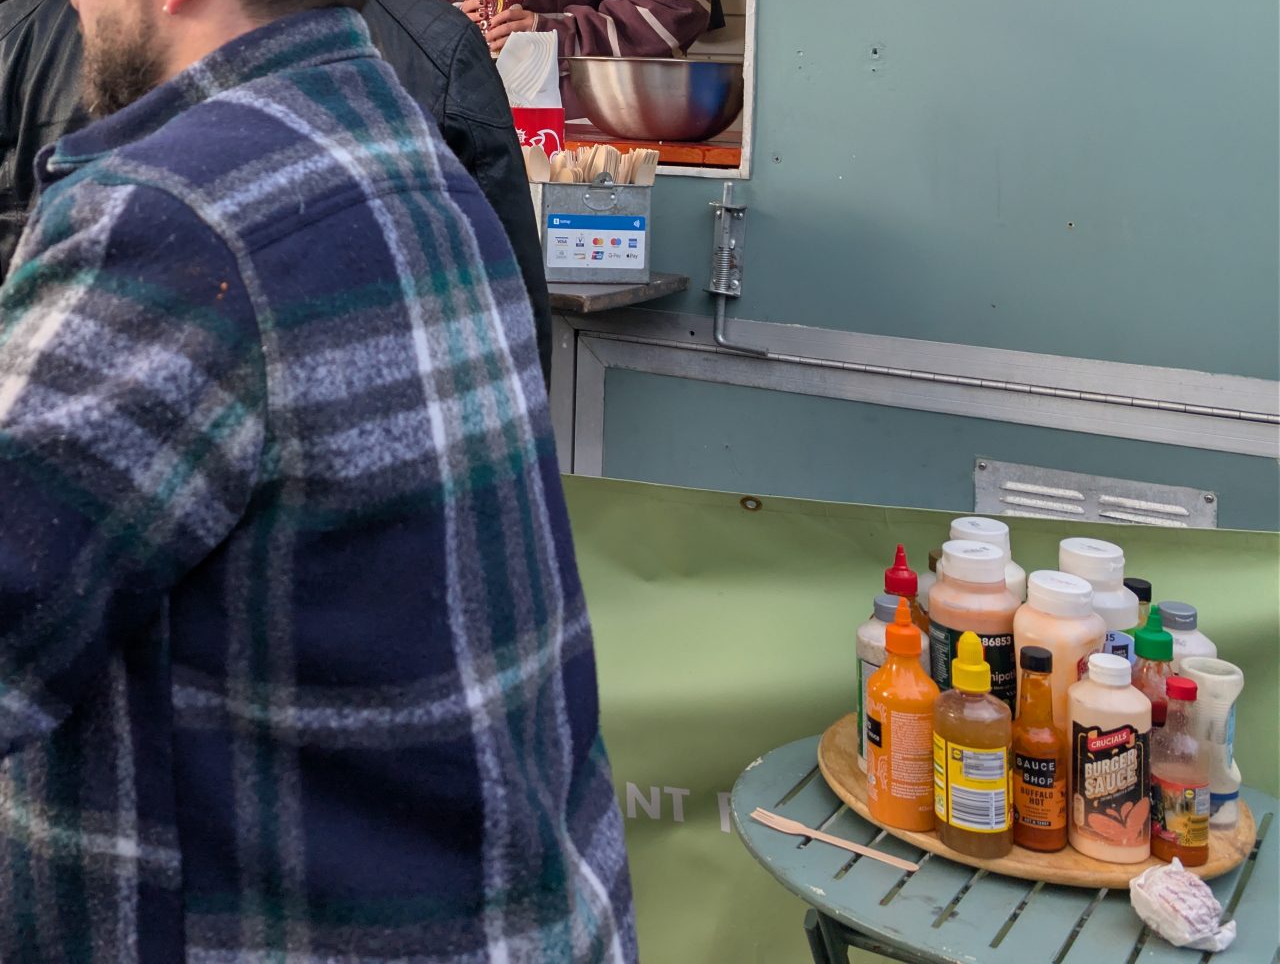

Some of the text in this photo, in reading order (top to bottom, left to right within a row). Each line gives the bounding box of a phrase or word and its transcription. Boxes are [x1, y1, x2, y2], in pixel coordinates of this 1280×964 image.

[980, 636, 1011, 646] 86853
[1091, 732, 1127, 749] CRUCIALS
[1016, 757, 1056, 771] SAUCE
[1085, 749, 1137, 777] BURGER
[1023, 774, 1053, 786] SHOP
[1085, 766, 1137, 798] SAUCE
[1020, 786, 1054, 799] BUFFALO
[1028, 795, 1045, 806] HOT
